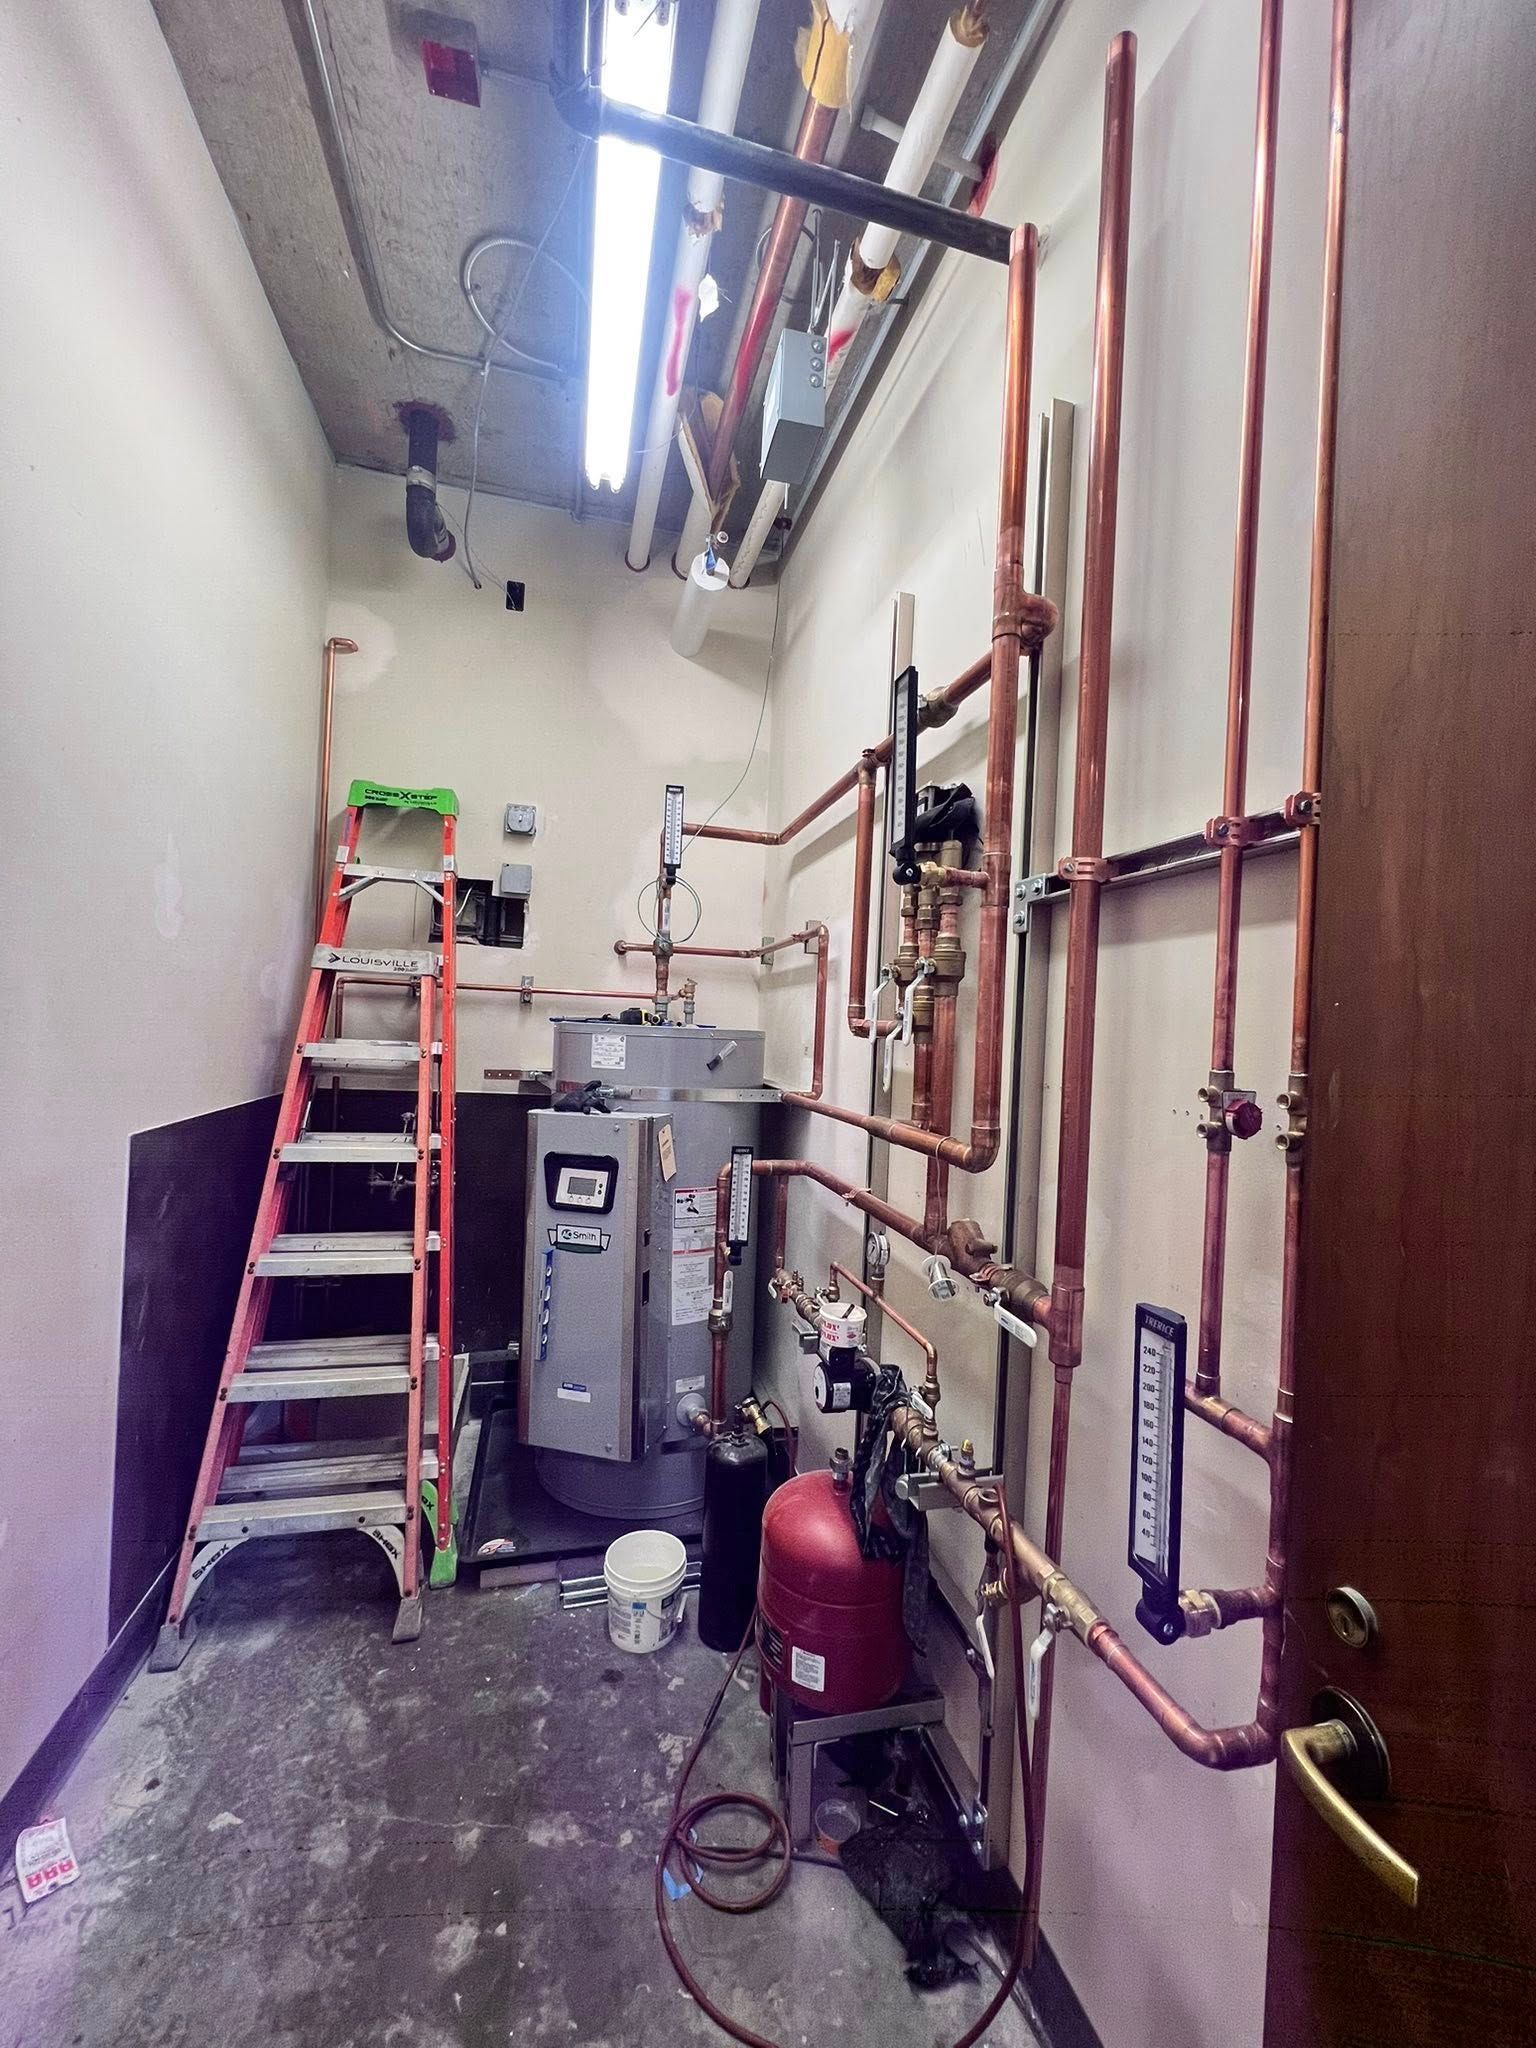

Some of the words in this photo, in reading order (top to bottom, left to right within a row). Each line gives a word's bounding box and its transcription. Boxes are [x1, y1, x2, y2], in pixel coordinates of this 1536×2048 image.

[342, 956, 418, 968] LOUISVILLE
[573, 1231, 597, 1241] Smith
[1145, 1314, 1175, 1337] TRERICE
[1143, 1345, 1156, 1357] 240
[1143, 1364, 1156, 1375] 220
[1142, 1382, 1155, 1393] 200
[1143, 1418, 1154, 1429] 160
[1142, 1436, 1154, 1447] 140
[1142, 1454, 1153, 1466] 120
[1141, 1472, 1152, 1484] 100
[1141, 1528, 1151, 1538] 40
